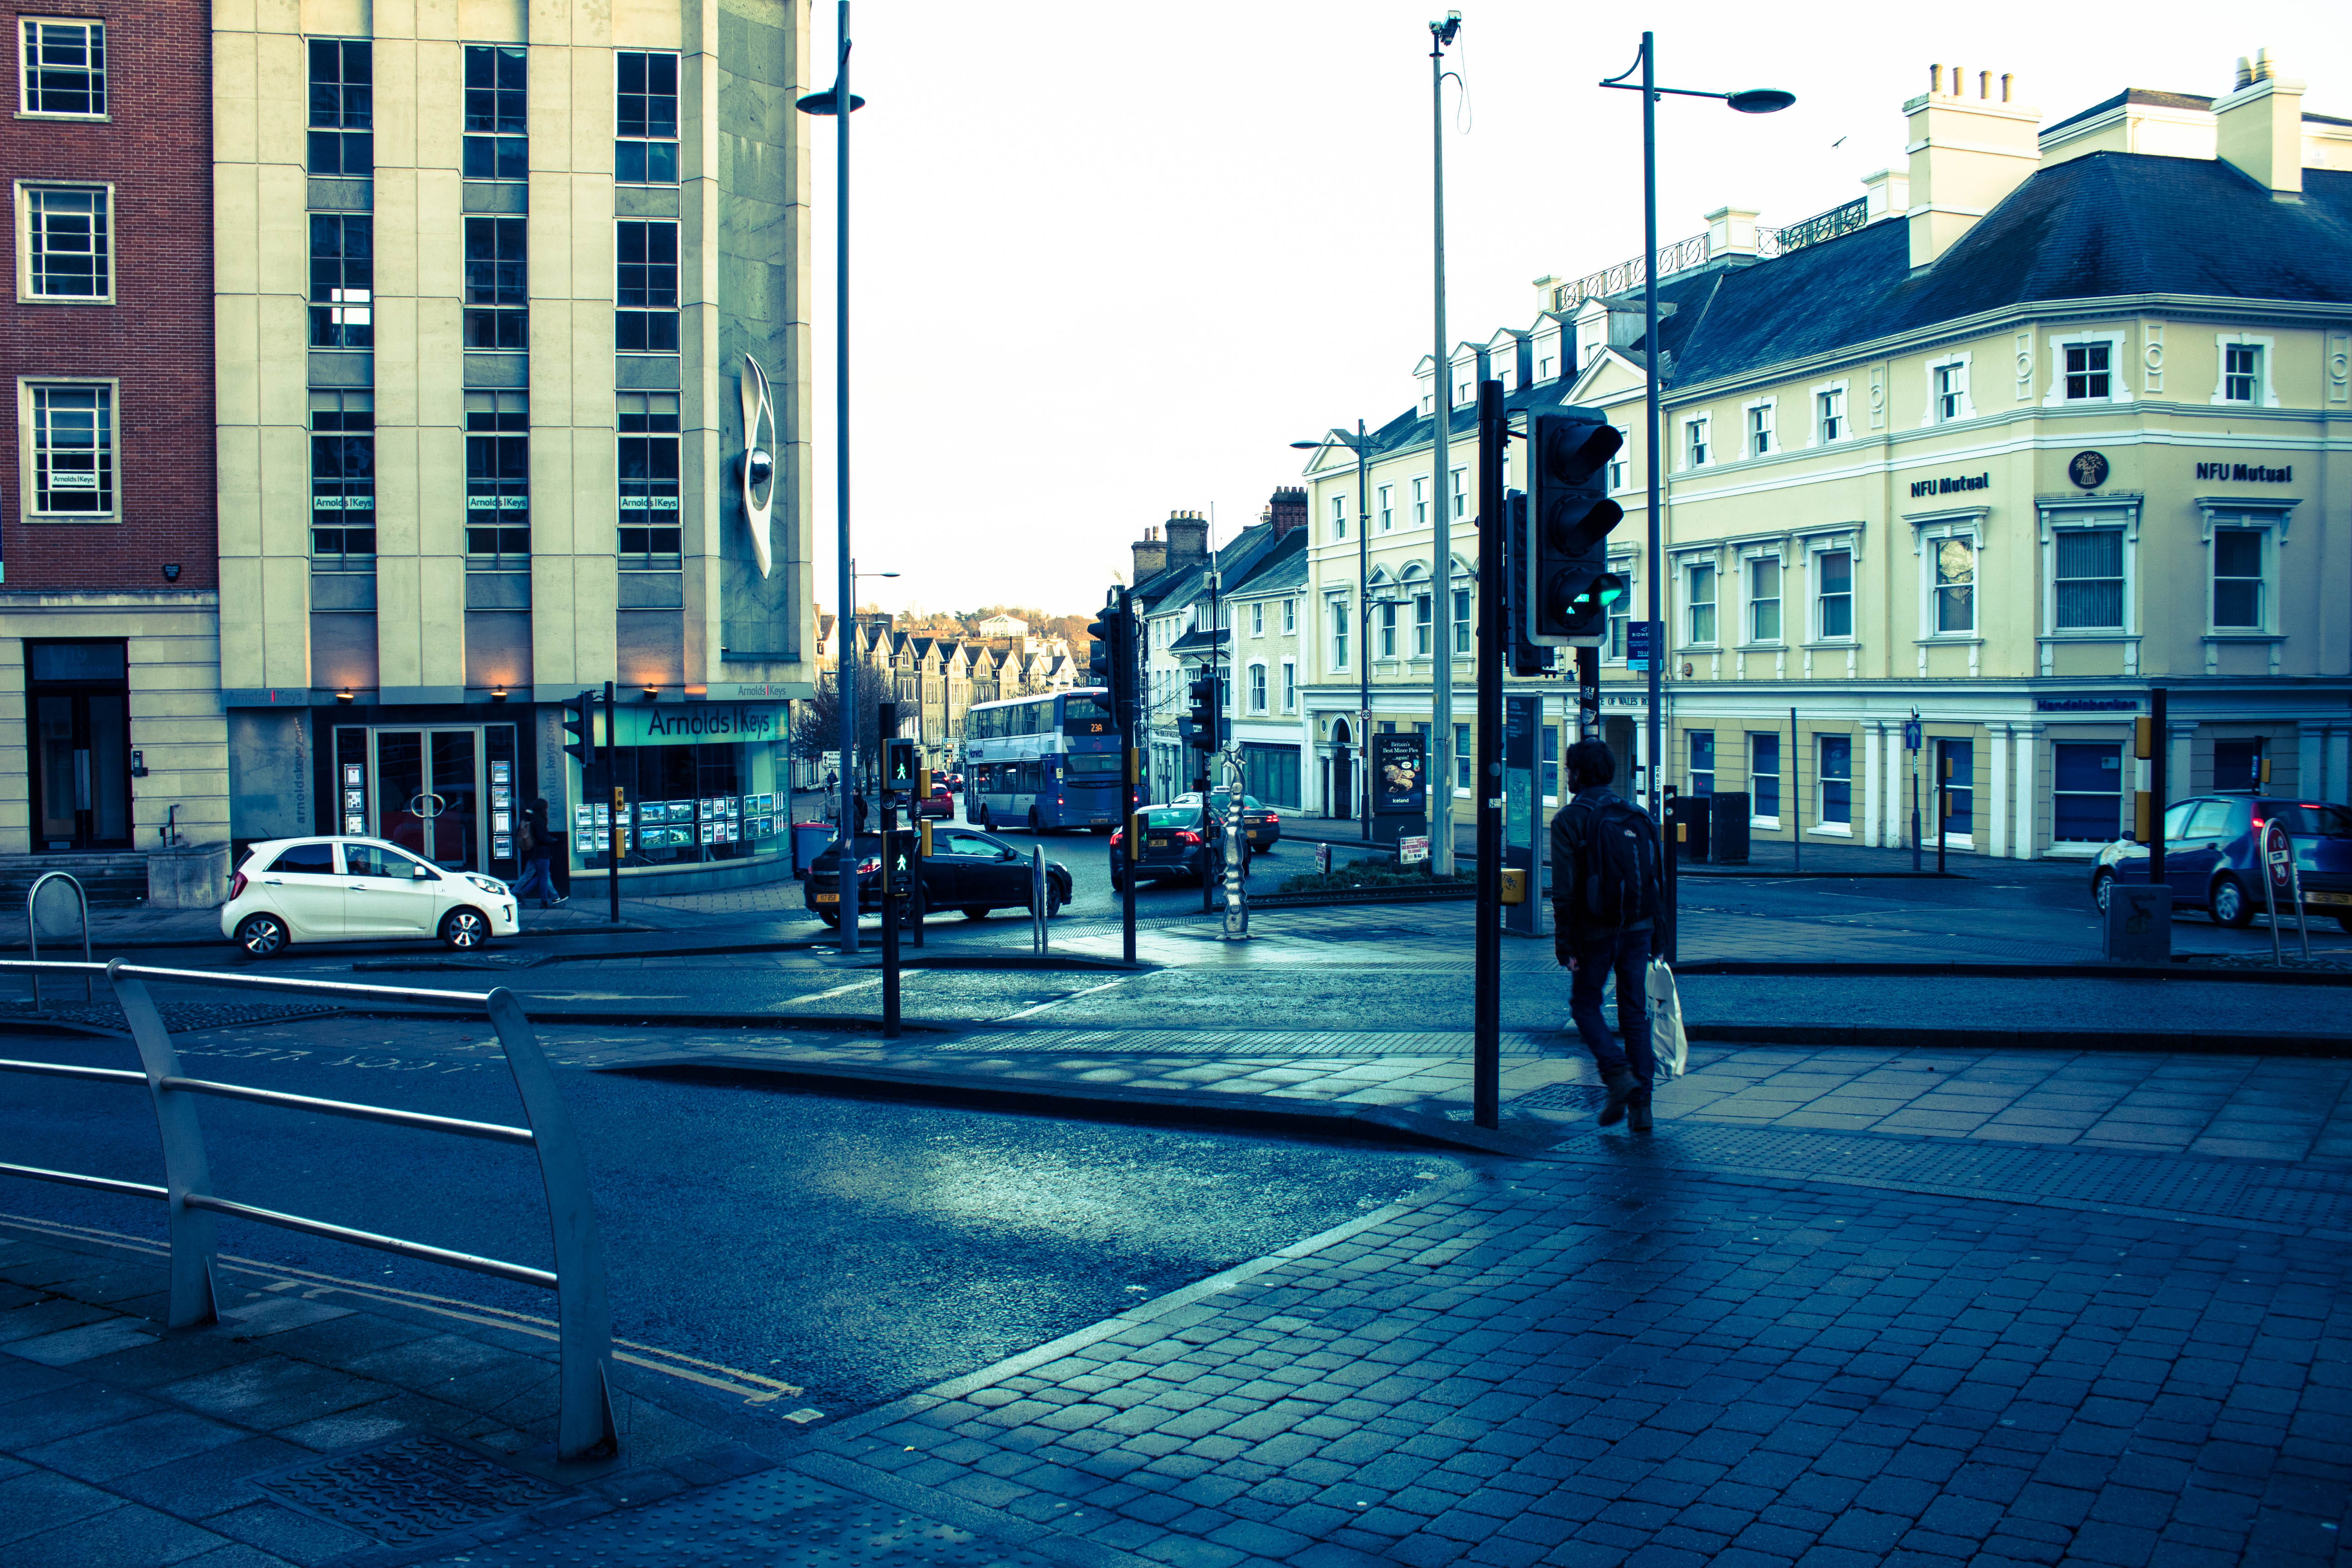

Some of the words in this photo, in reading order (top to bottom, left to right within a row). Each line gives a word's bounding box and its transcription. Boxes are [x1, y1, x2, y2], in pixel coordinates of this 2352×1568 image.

[2197, 462, 2230, 480] NFU
[2233, 464, 2292, 482] Mutual
[1911, 480, 1937, 498] NFU
[1940, 472, 1989, 494] Mutual
[316, 498, 348, 506] Arnolds
[353, 498, 372, 509] Keys
[470, 498, 502, 506] Arnolds
[507, 498, 526, 509] Keys
[658, 499, 676, 509] Keys
[228, 691, 270, 702] Arnolds
[277, 691, 303, 704] Keys
[738, 686, 766, 696] Arnolds
[769, 686, 786, 698] Keys
[1618, 697, 1637, 706] WALES
[1641, 697, 1649, 706] RO
[2037, 699, 2137, 711] Handelsbanken
[648, 708, 730, 735] Arnolds
[740, 706, 769, 740] Keys
[1091, 724, 1102, 732] 23A
[969, 748, 983, 758] Norwich
[294, 716, 306, 824] arnoldskeys.com
[544, 714, 559, 819] arnoldskeys.com
